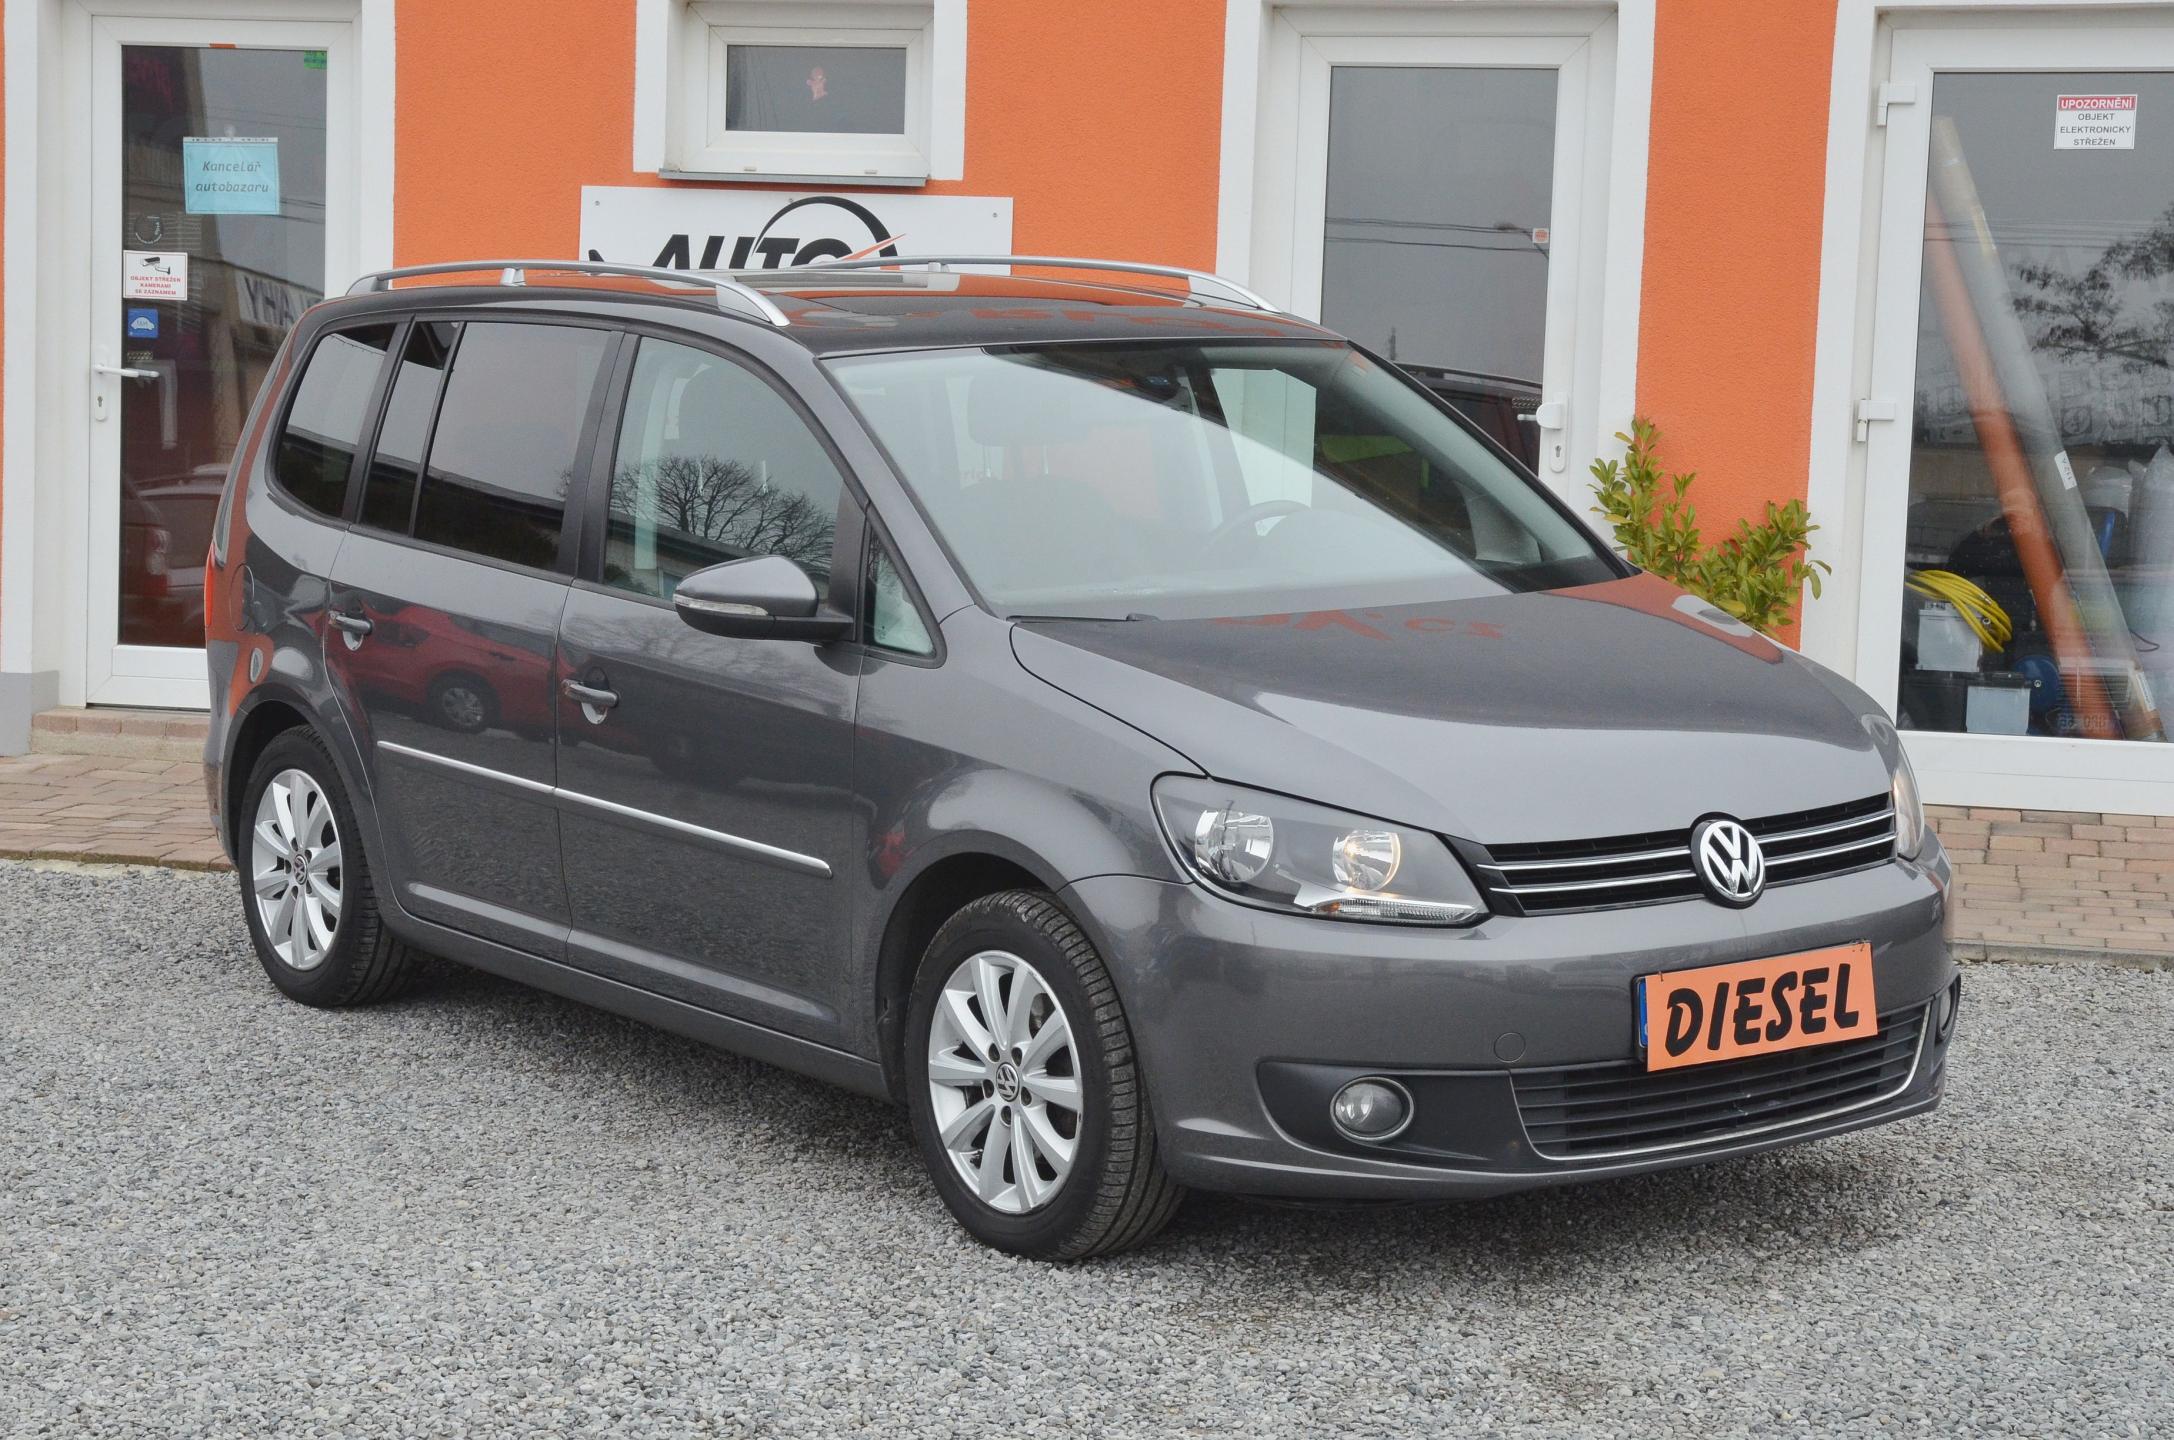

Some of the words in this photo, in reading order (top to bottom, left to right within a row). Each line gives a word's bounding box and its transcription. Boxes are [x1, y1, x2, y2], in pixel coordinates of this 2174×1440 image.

[2060, 97, 2133, 109] UPOZORNĚNÍ
[2077, 113, 2115, 121] OBJEKT
[2060, 126, 2131, 134] ELEKTRONICKY
[195, 181, 269, 193] autobazaru
[1664, 963, 1859, 1058] DIESEL
